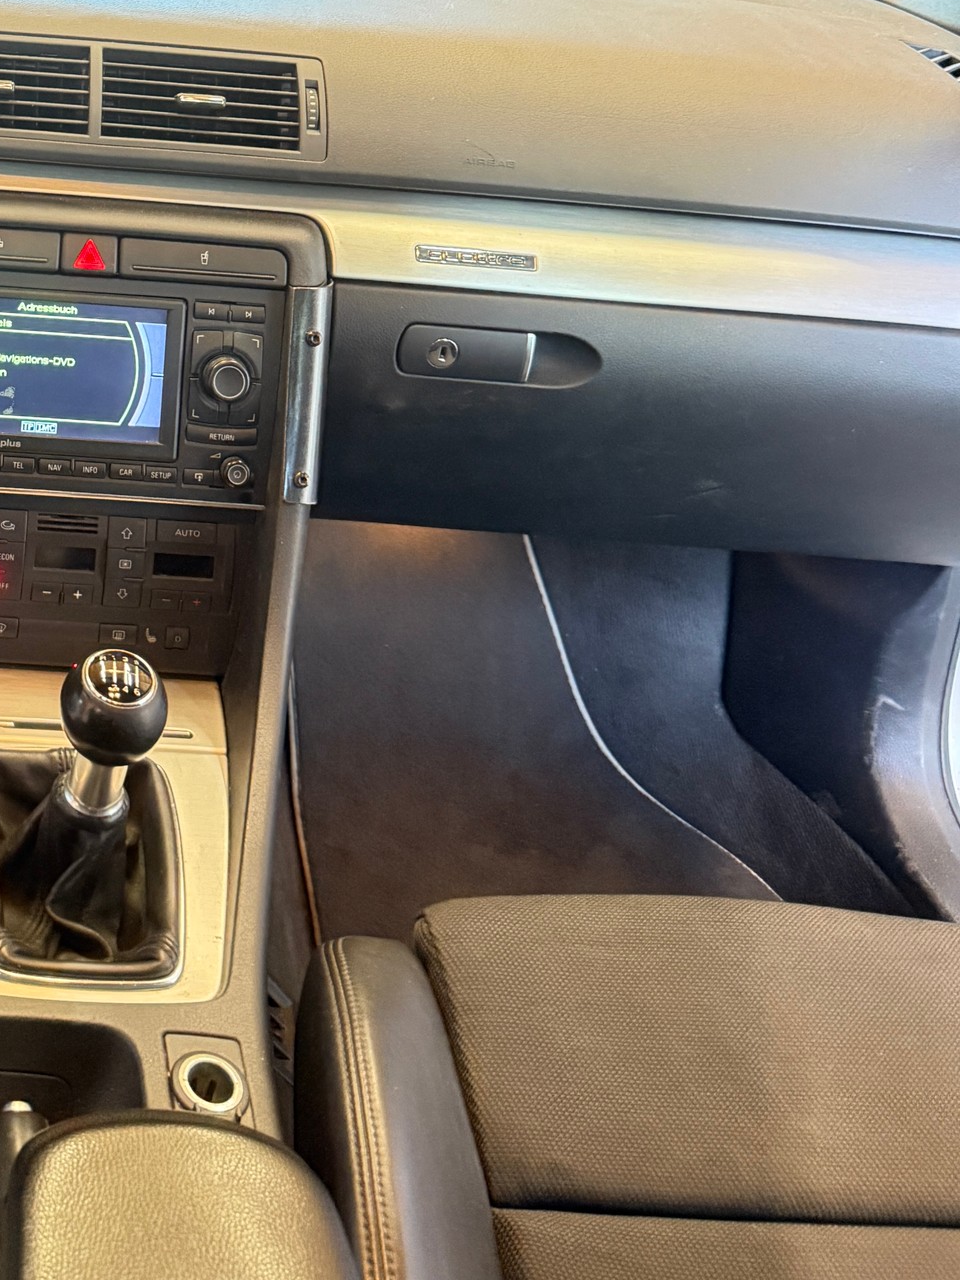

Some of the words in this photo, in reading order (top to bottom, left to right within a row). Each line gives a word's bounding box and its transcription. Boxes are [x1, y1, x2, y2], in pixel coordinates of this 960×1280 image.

[17, 301, 78, 316] Adressbuch
[209, 432, 235, 442] RETURN
[0, 438, 22, 449] plus
[13, 461, 25, 470] TEL
[47, 463, 62, 472] NAV
[82, 466, 98, 474] INFO
[119, 468, 133, 476] CAR
[150, 471, 172, 480] SETUP
[175, 528, 201, 538] AUTO
